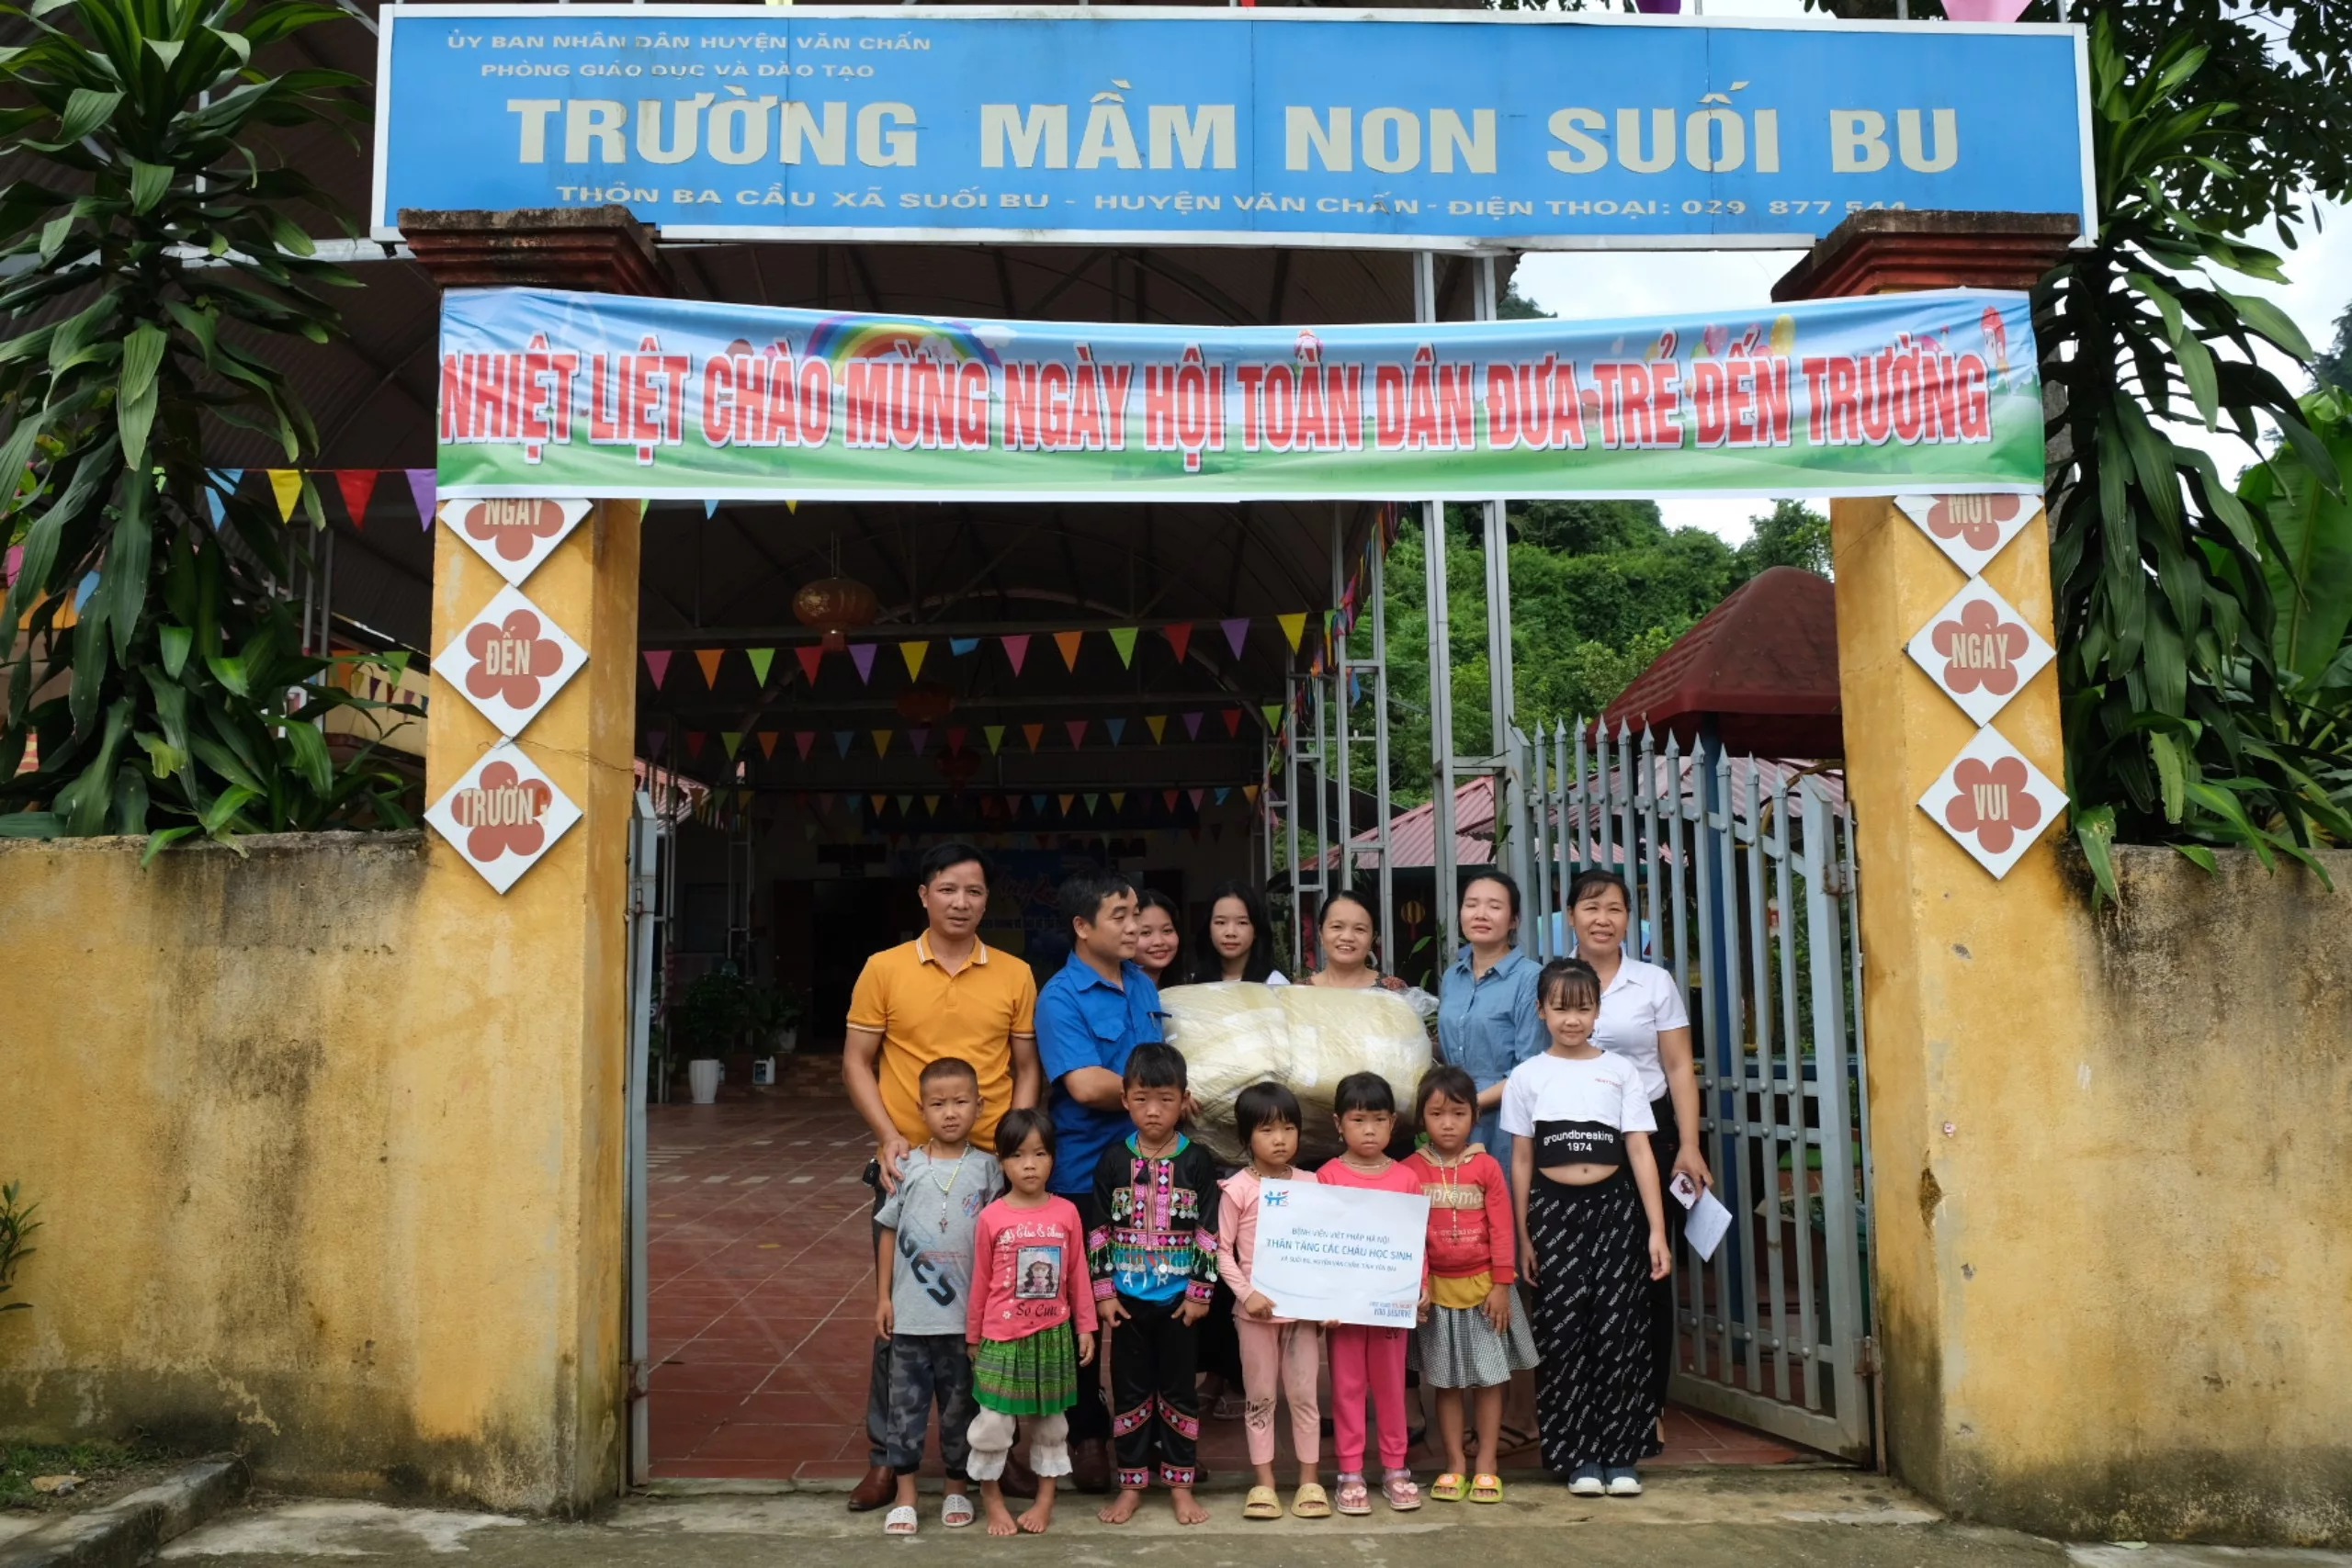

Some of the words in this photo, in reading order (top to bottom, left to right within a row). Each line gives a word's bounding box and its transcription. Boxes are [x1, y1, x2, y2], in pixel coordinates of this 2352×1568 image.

[448, 29, 482, 48] ỦY
[492, 36, 544, 48] BAN
[553, 31, 626, 48] NHÂN
[636, 31, 689, 48] DÂN
[701, 33, 786, 52] HUYỆN
[797, 33, 850, 50] VĂN
[859, 31, 931, 50] CHẤN
[481, 60, 570, 76] PHÒNG
[580, 60, 642, 76] GIÁO
[651, 64, 705, 80] DỤC
[714, 60, 749, 77] VÀ
[822, 64, 876, 81] TẠO
[507, 85, 917, 167] TRƯỜNG
[980, 77, 1237, 169] MẦM
[1285, 106, 1497, 174] NON
[1547, 80, 1779, 175] SUỐI
[1829, 107, 1959, 174] BU
[556, 181, 659, 203] THÔN
[673, 188, 722, 204] BA
[736, 183, 816, 207] CẦU
[832, 186, 886, 208] XÃ
[899, 186, 988, 209] SUỐI
[1000, 193, 1048, 209] BU
[1094, 191, 1220, 215] HUYỆN
[1233, 192, 1306, 212] VĂN
[1316, 191, 1419, 215] CHẤN
[1446, 196, 1532, 220] ĐIỆN
[1545, 200, 1669, 220] THOẠI:
[1681, 200, 1746, 215] 029
[1769, 200, 1831, 215] 877
[439, 330, 582, 466] NHIỆT
[589, 333, 693, 466] LIỆT
[701, 336, 832, 449] CHÀO
[843, 337, 993, 452] MỪNG
[1002, 341, 1135, 452] NGÀY
[1142, 343, 1227, 473] HỘI
[1236, 343, 1365, 454] TOÀN
[1377, 342, 1476, 452] DÂN
[1485, 352, 1587, 451] ĐƯA
[1592, 328, 1685, 449] TRẺ
[1691, 323, 1792, 449] ĐẾN
[1803, 332, 1993, 446] TRƯỜNG
[486, 626, 531, 675] ĐẾN
[1951, 624, 2008, 670] NGÀY
[459, 779, 549, 827] TRƯỜNG
[1973, 784, 2009, 821] VUI
[1544, 1129, 1614, 1146] groundbreaking
[1567, 1142, 1592, 1152] 1974
[1390, 1251, 1413, 1261] SINH
[1123, 1271, 1169, 1289] AIR
